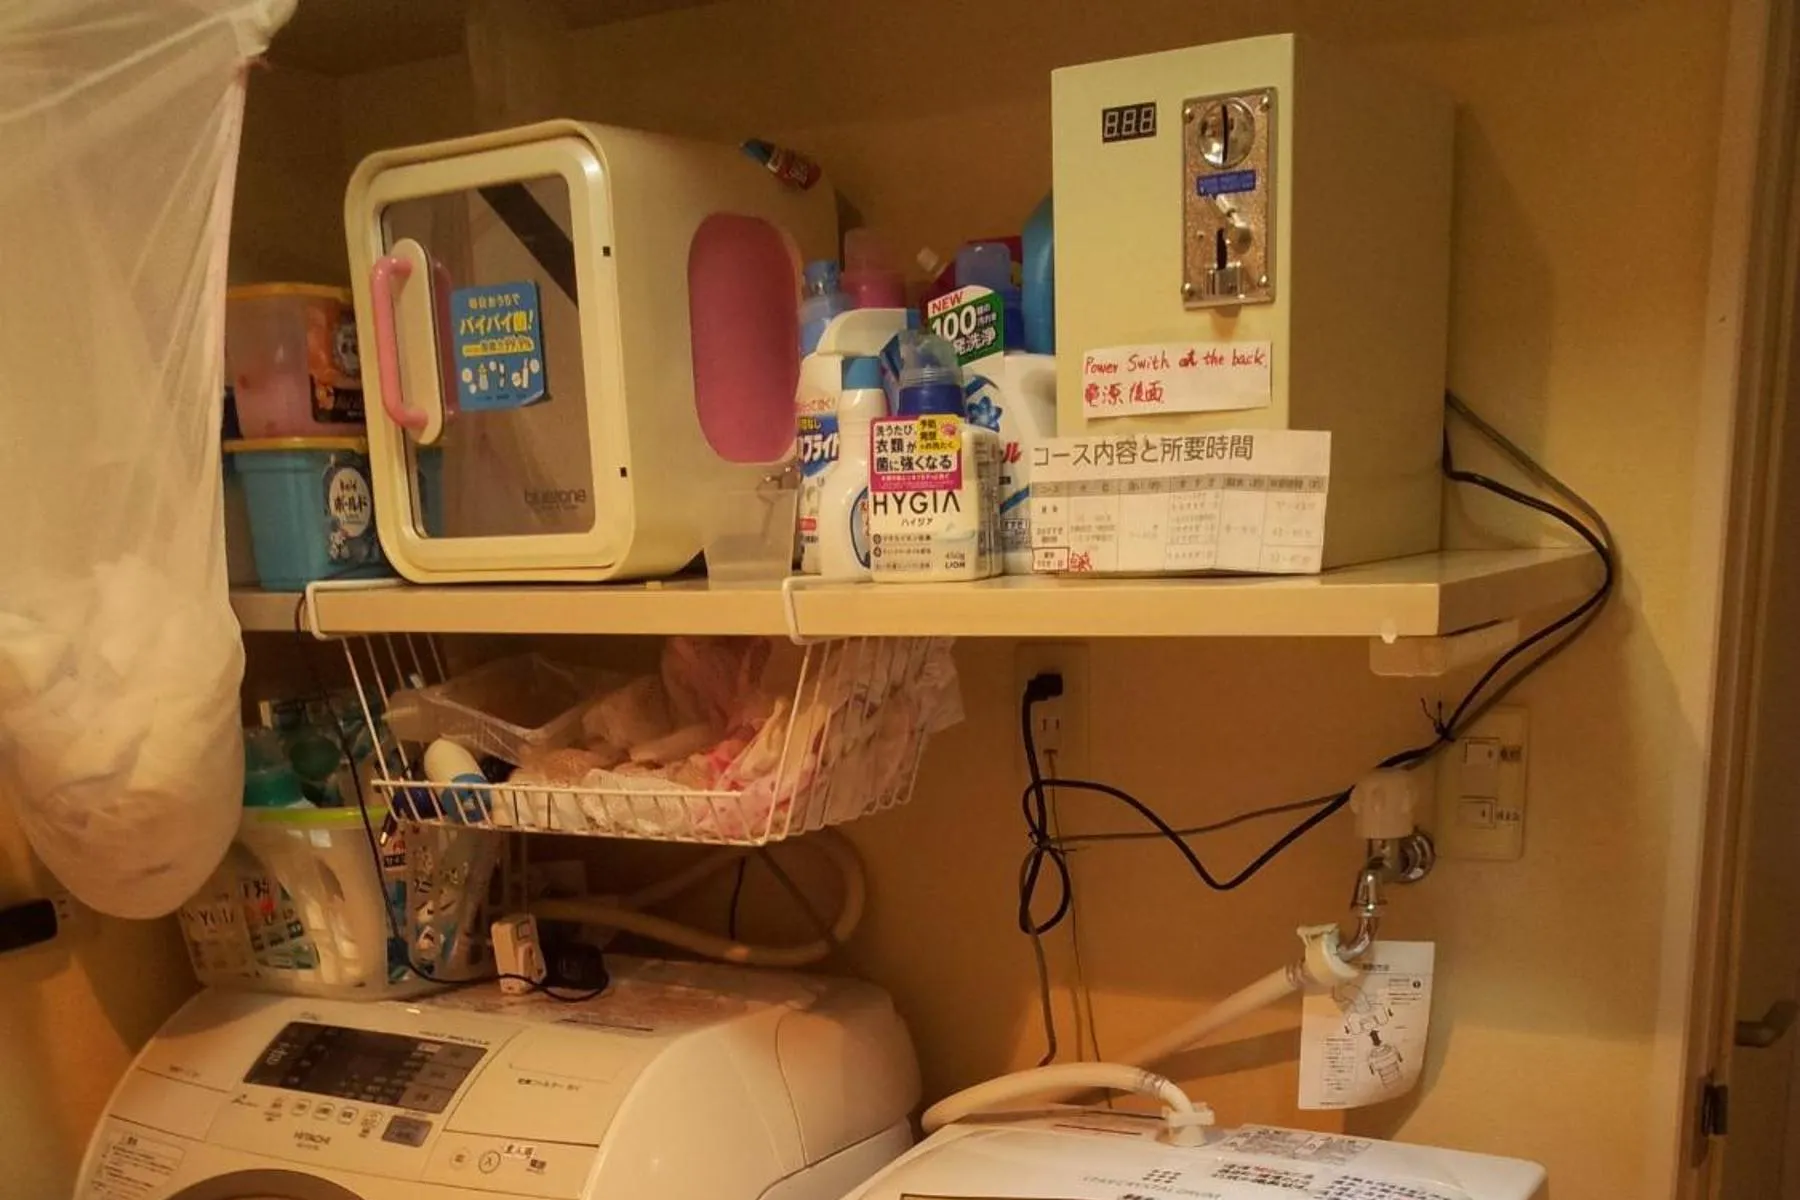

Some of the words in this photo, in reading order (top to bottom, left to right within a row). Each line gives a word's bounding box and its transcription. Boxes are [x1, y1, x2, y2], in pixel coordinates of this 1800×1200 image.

[931, 290, 965, 314] NEW
[1084, 356, 1119, 375] Power
[1203, 347, 1225, 367] the
[1033, 433, 1254, 467] コース内容と所要時間
[873, 490, 961, 516] HYGIA
